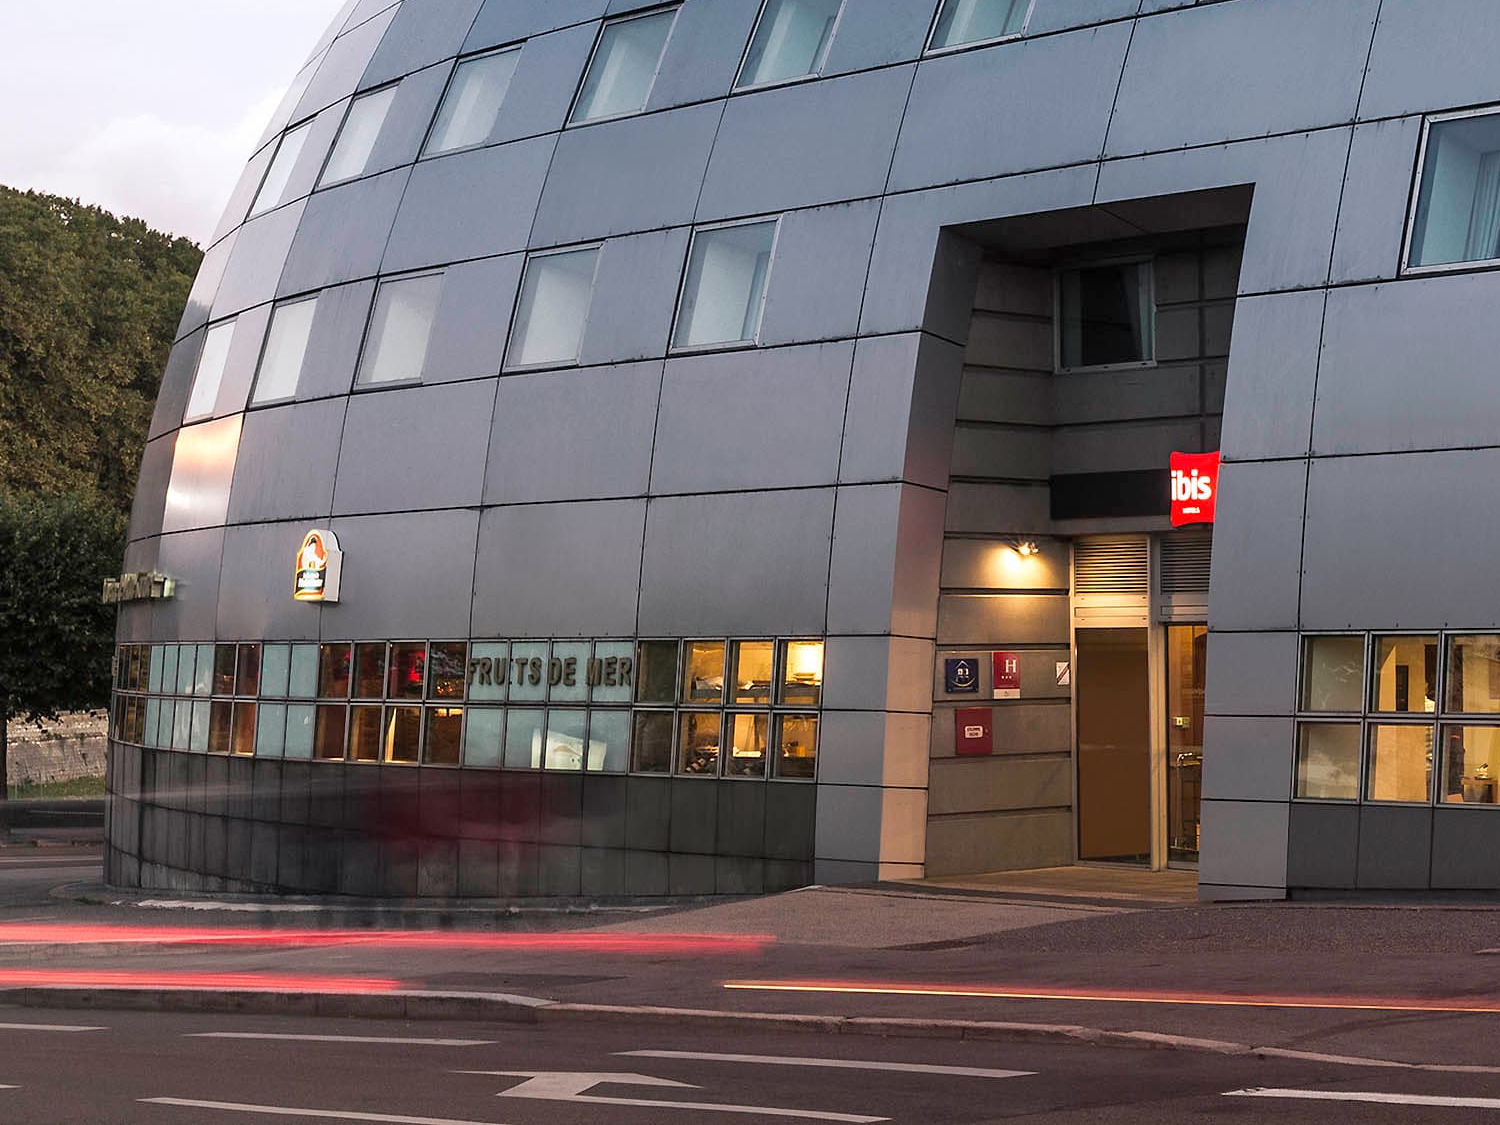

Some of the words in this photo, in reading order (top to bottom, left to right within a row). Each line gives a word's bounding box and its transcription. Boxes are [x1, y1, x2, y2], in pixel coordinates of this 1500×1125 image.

[1170, 468, 1212, 501] ibis
[547, 657, 576, 686] DE
[586, 656, 632, 686] MER
[1004, 658, 1017, 674] H
